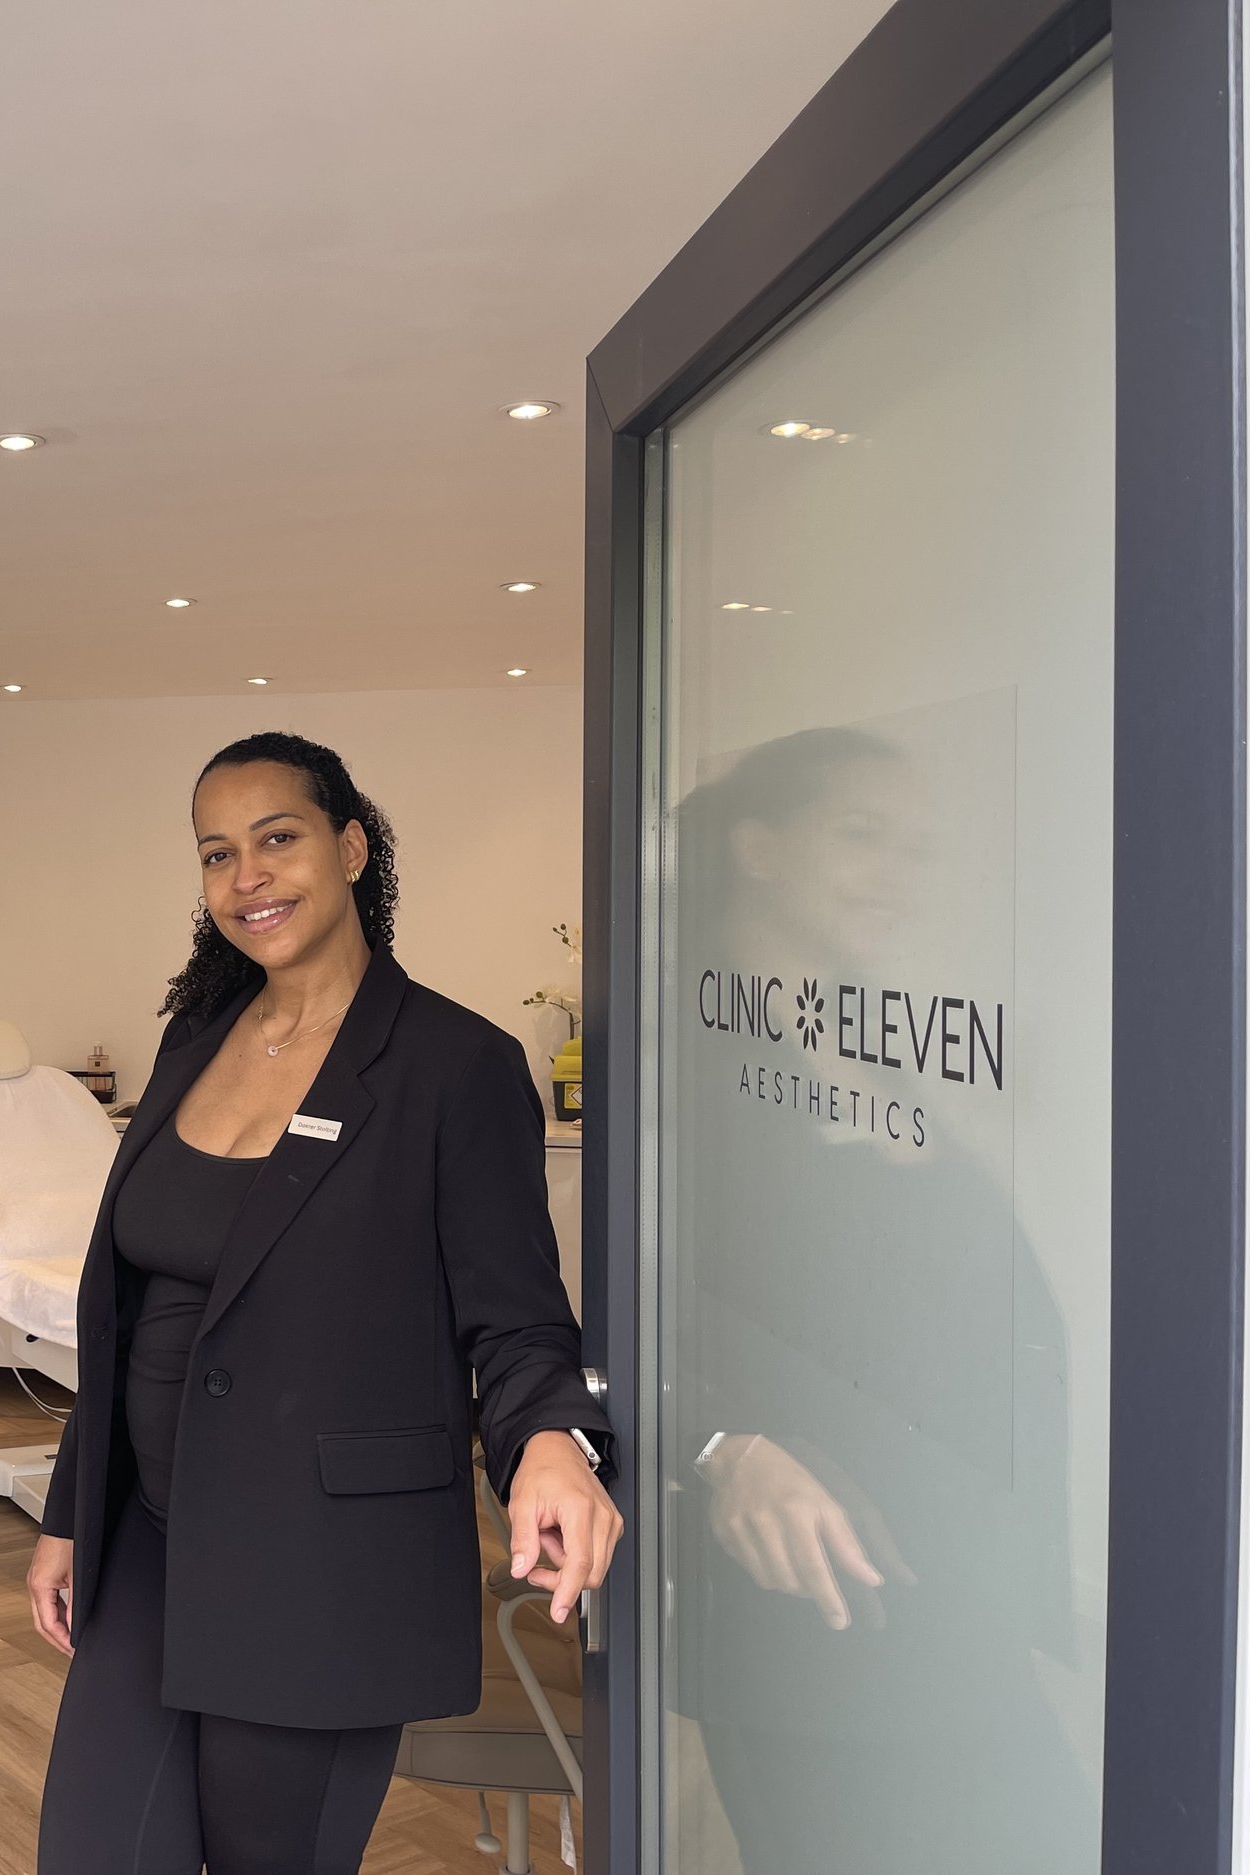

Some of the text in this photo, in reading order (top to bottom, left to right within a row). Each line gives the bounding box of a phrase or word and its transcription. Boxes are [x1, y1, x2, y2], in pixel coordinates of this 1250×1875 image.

[700, 969, 1002, 1090] CLINIC ELEVEN
[739, 1063, 925, 1147] AESTHETICS
